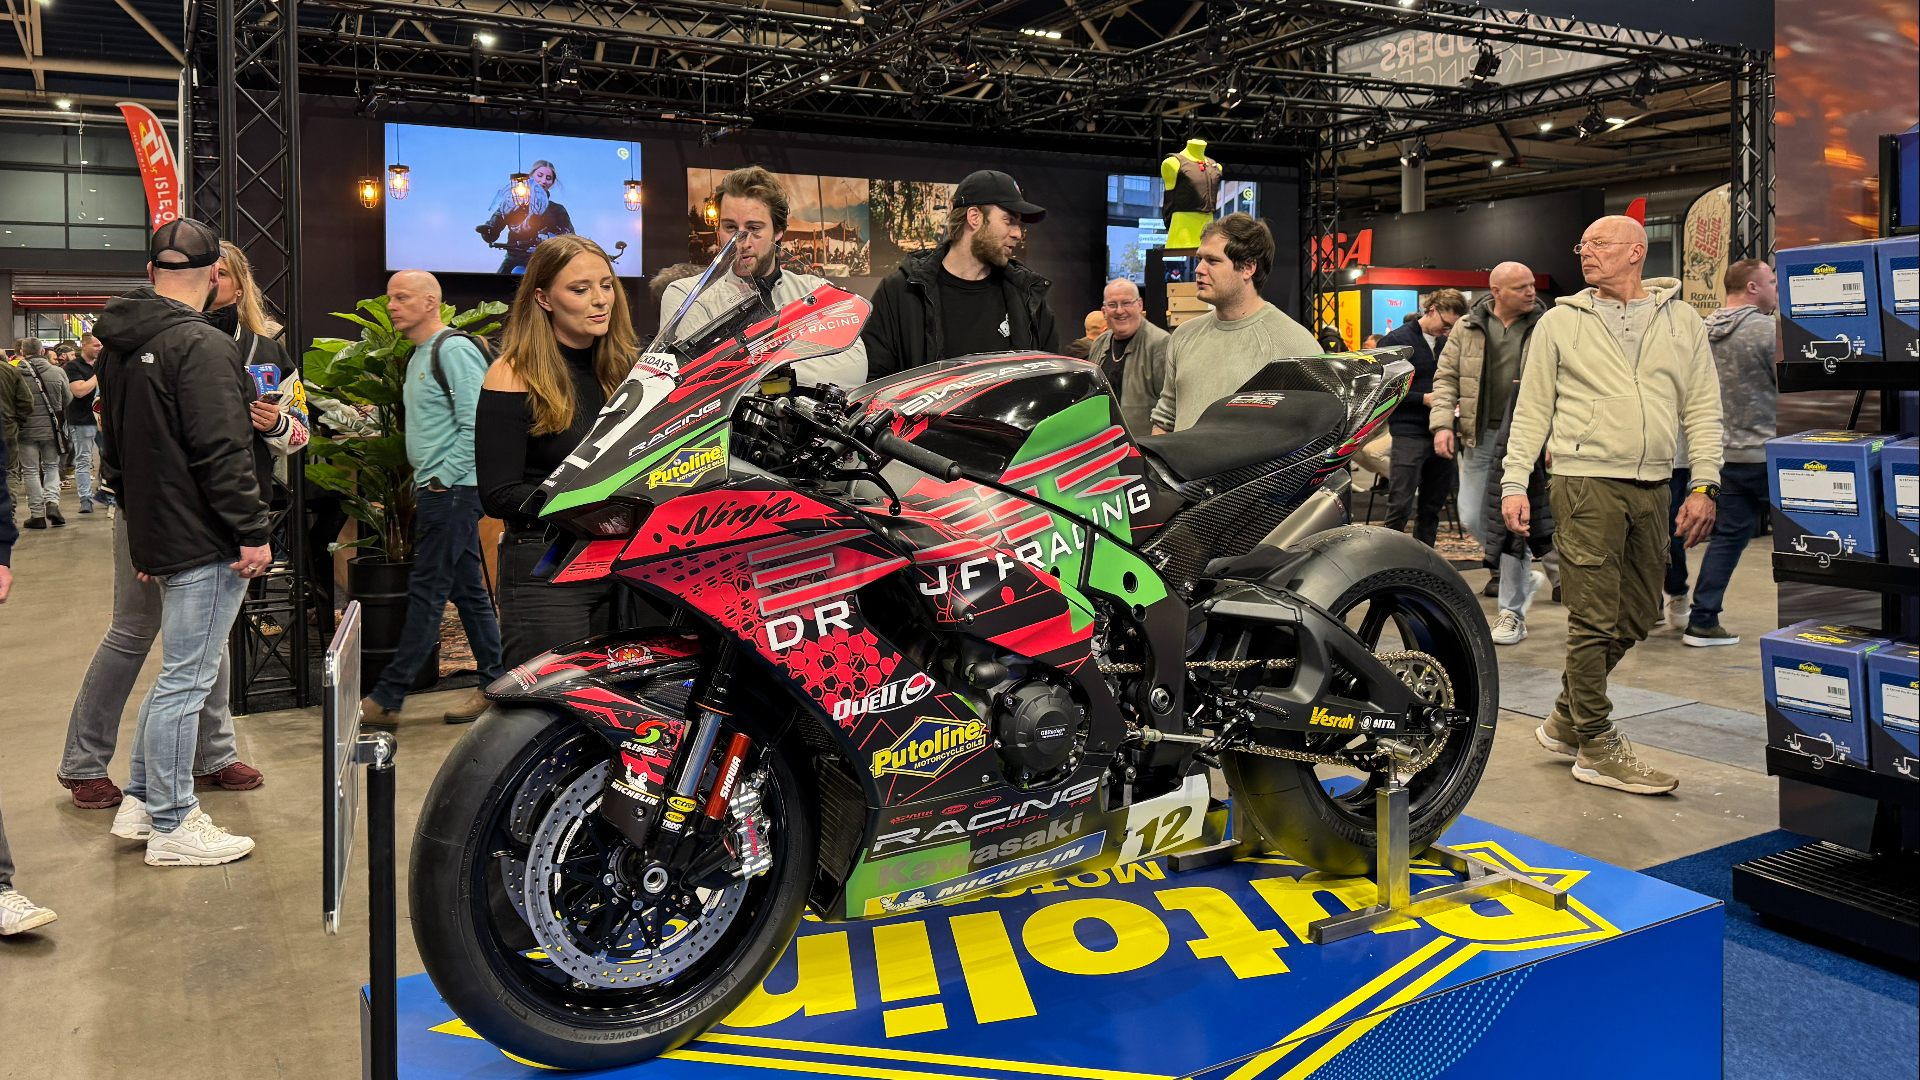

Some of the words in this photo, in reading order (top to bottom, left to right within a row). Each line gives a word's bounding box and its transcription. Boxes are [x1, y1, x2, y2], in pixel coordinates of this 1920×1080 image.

[140, 118, 169, 167] TT
[153, 176, 173, 207] ISLE
[1694, 216, 1708, 253] SLIDE
[1706, 216, 1722, 259] SCHOOL
[1691, 292, 1718, 301] ROYAL
[628, 399, 721, 457] RACING
[648, 446, 722, 489] Putoline
[667, 491, 801, 539] Ninja
[764, 599, 854, 652] DR
[1309, 706, 1356, 730] Vesrah
[873, 721, 982, 777] Putoline
[913, 746, 965, 770] MOTORCYCLE
[966, 738, 983, 751] OILS
[610, 781, 659, 806] MICHELIN
[719, 755, 742, 801] SHOWA
[1441, 757, 1482, 819] MICHELIN
[873, 776, 1100, 853] RACING
[1133, 805, 1197, 857] 12
[877, 812, 1084, 889] Kawasaki
[935, 845, 1085, 900] MICHELIN
[603, 1028, 640, 1042] POWER
[649, 994, 714, 1034] MICHELIN
